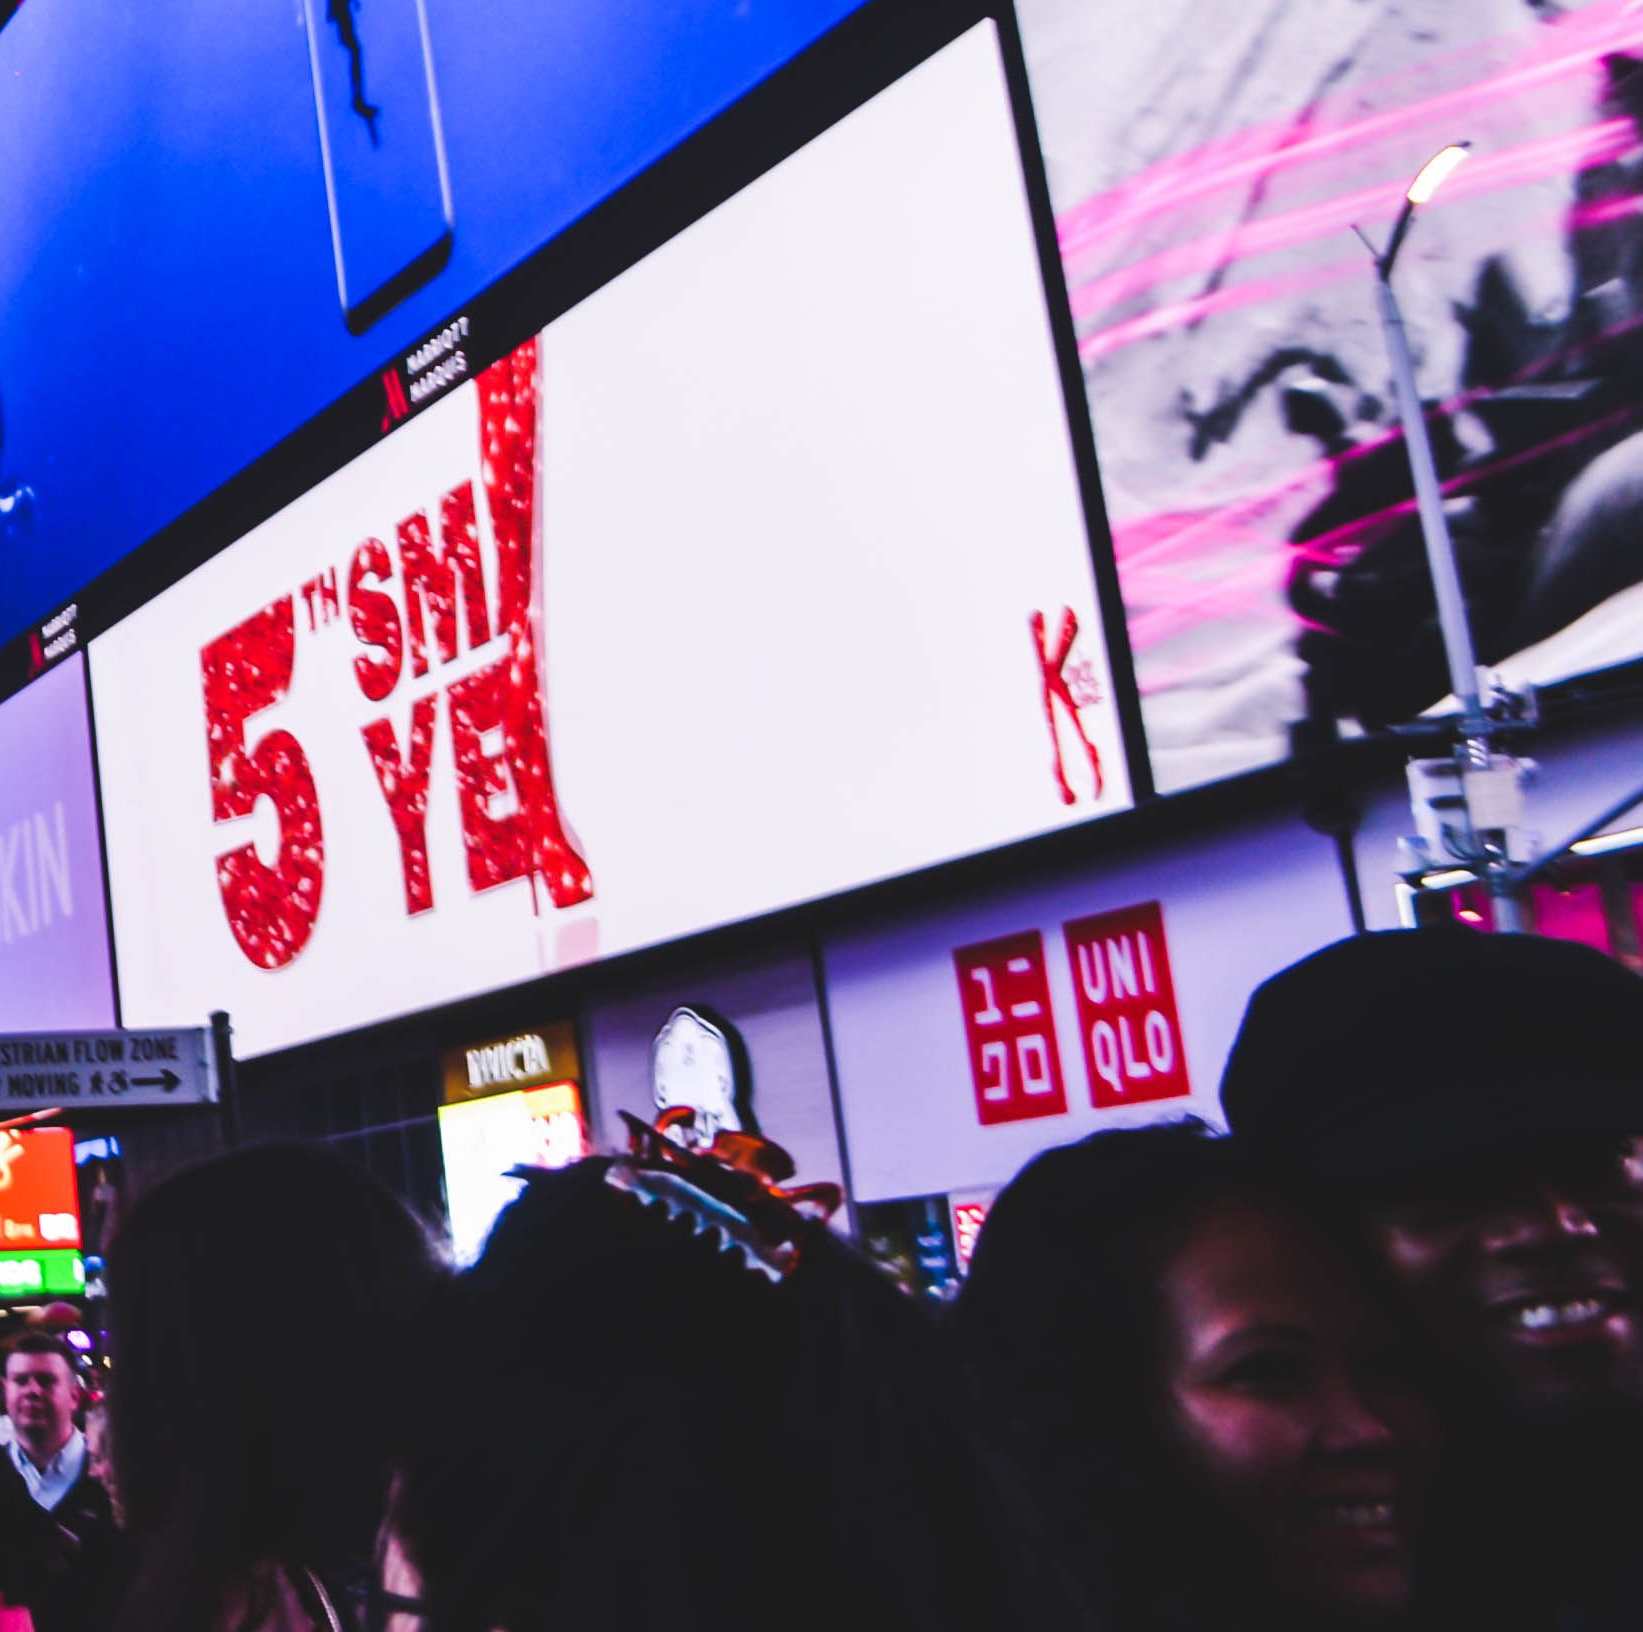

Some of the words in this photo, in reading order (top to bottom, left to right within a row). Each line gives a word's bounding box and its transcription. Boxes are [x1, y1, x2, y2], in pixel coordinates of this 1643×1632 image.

[406, 316, 469, 376] MARRIOTT
[409, 350, 468, 403] MARQUIS
[1077, 929, 1156, 1005] UNI
[73, 1038, 125, 1063] FLOW
[130, 1036, 179, 1061] ZONE
[1091, 1009, 1173, 1094] QLO
[7, 1071, 81, 1096] MOVING
